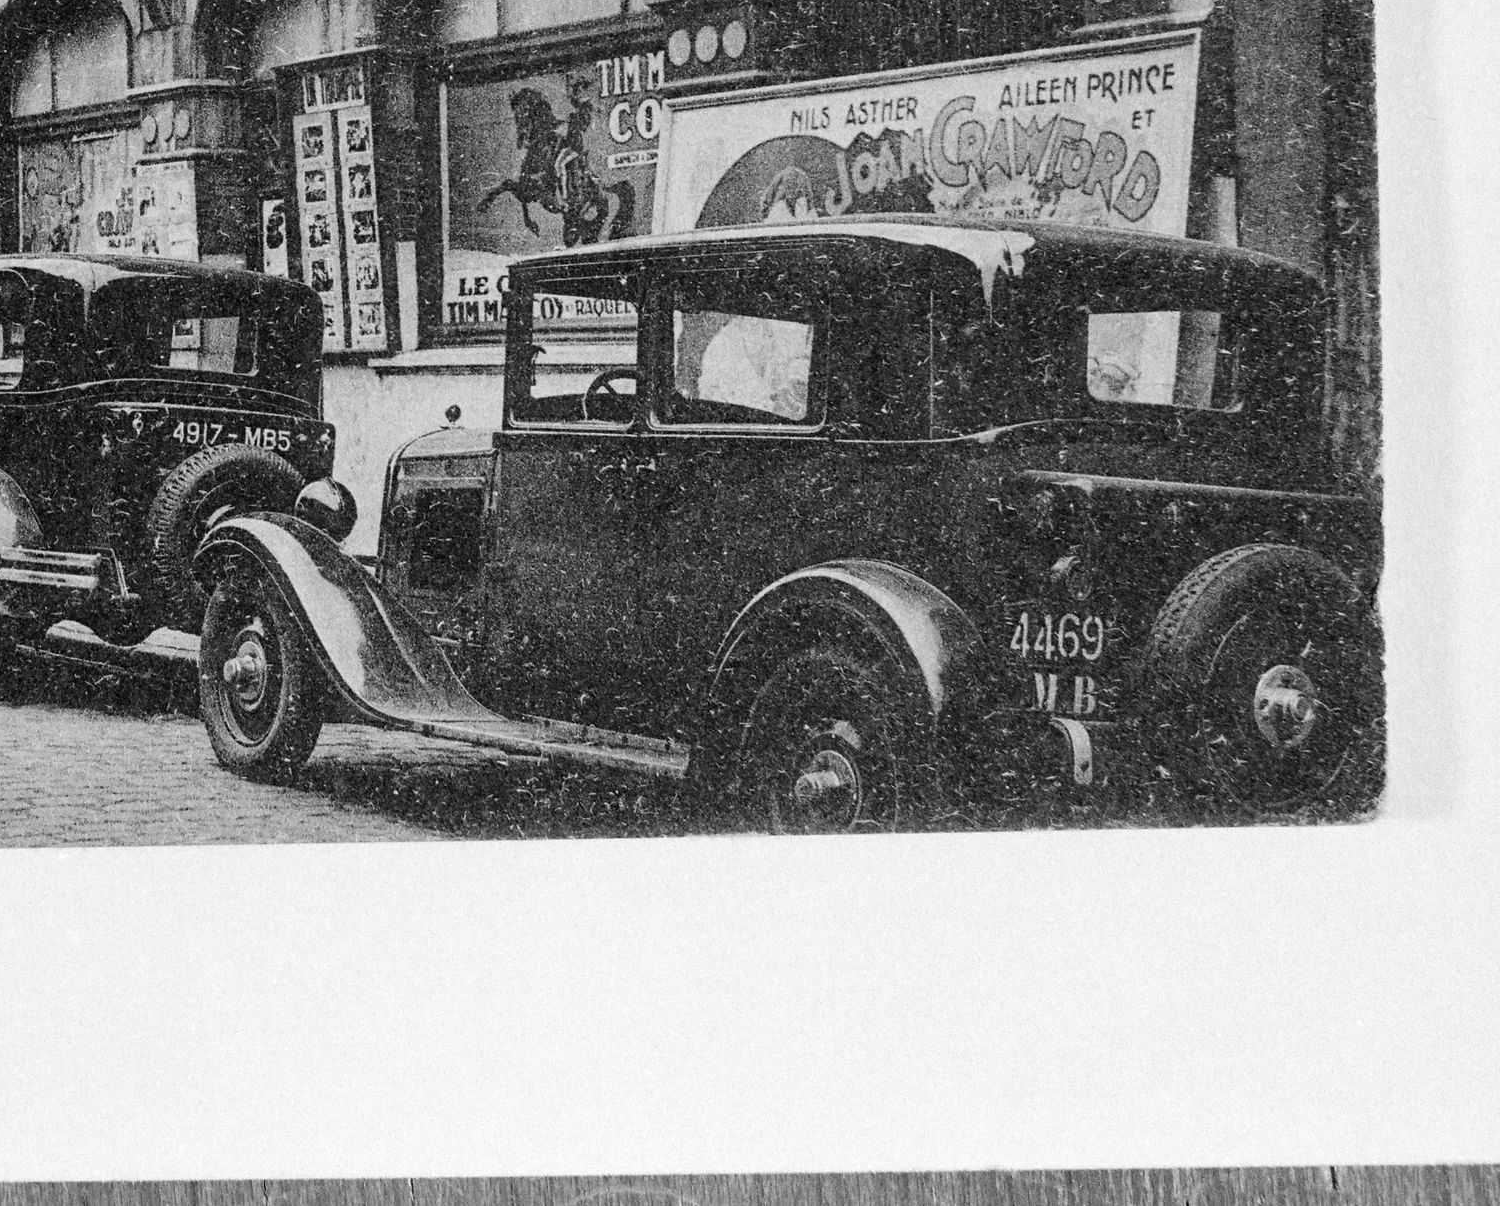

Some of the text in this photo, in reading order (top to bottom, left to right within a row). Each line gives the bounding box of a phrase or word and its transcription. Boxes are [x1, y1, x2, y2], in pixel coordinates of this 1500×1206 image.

[998, 76, 1077, 109] AILEEN
[608, 98, 661, 143] CO
[790, 96, 918, 132] NILS ASTHER
[1131, 108, 1156, 130] ET
[929, 95, 1162, 223] CRAWFORD
[458, 275, 490, 297] LE
[1010, 612, 1104, 661] 4469
